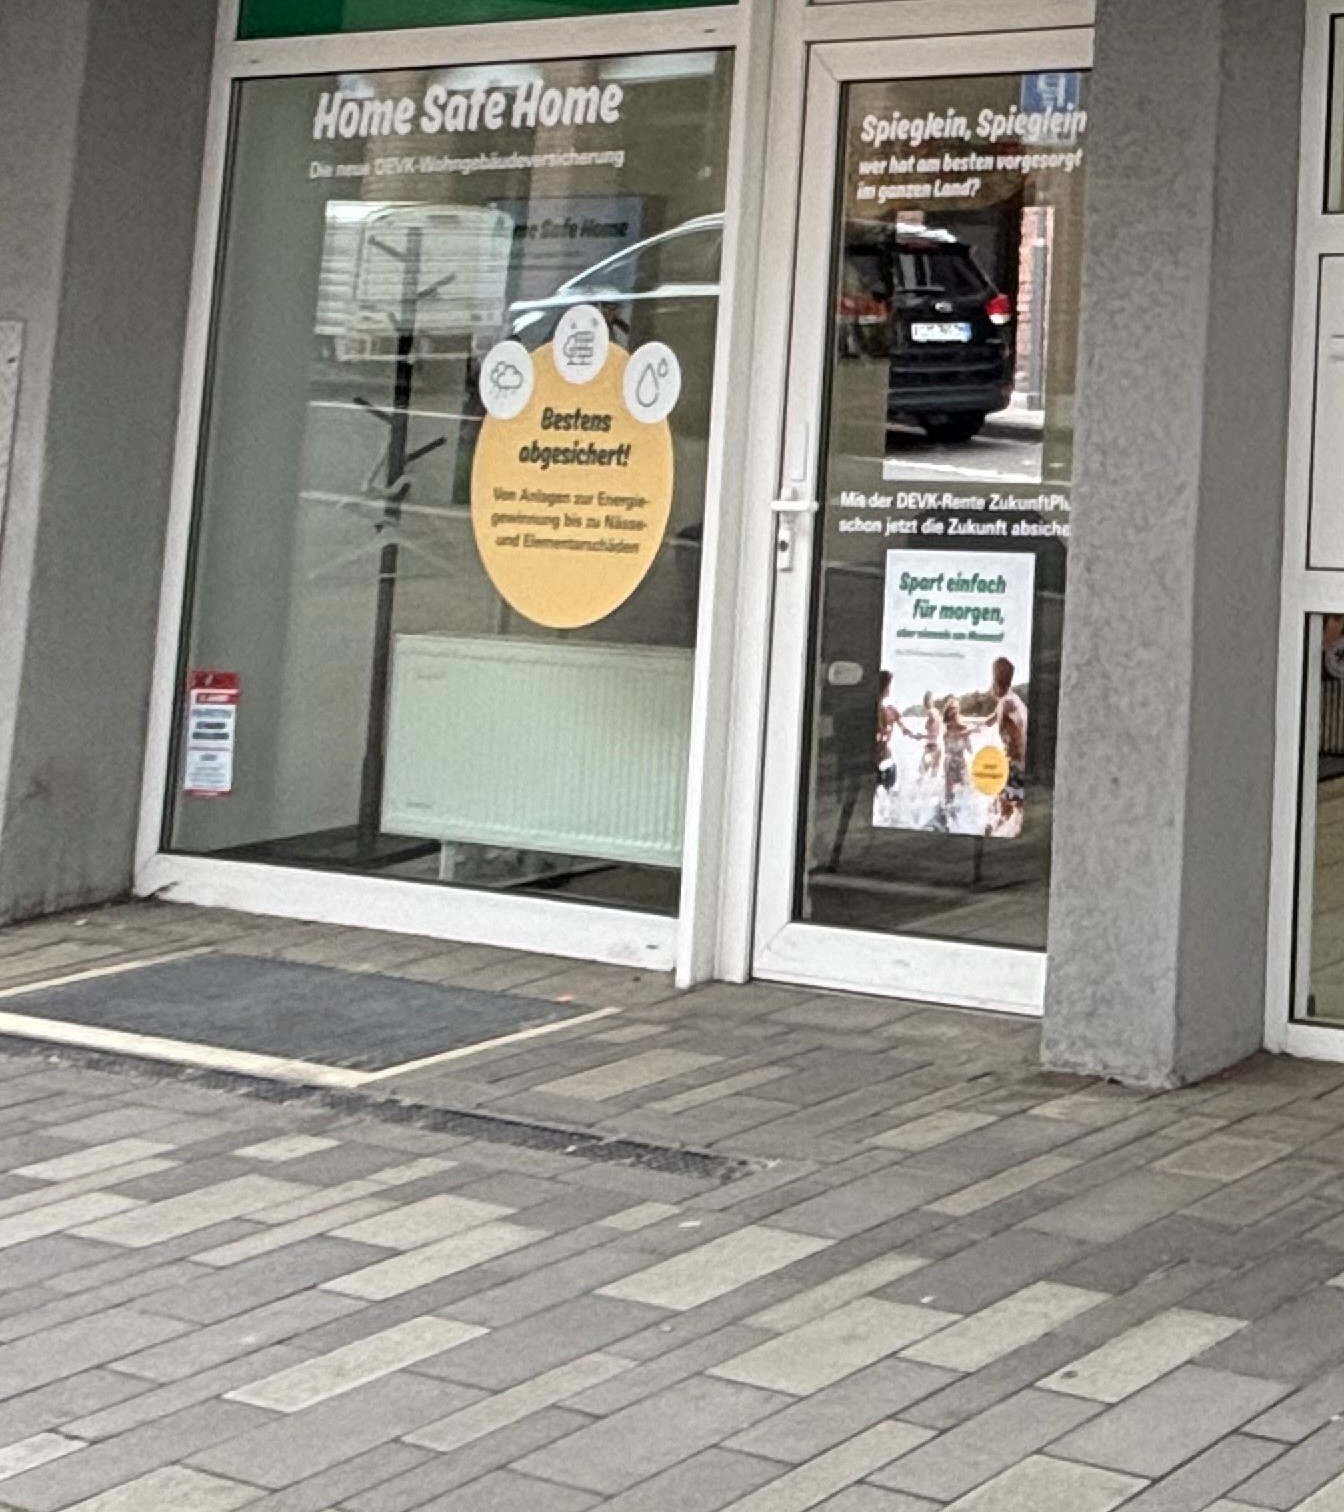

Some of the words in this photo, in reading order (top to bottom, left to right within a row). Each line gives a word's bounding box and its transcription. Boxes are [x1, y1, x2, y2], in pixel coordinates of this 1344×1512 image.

[312, 92, 416, 139] Home
[420, 84, 506, 133] Safe
[511, 79, 624, 128] Home
[861, 108, 972, 147] Spieglein,
[942, 152, 994, 172] besten
[541, 406, 613, 433] Bestens
[519, 439, 632, 472] abgesichert!
[868, 492, 893, 509] der
[884, 516, 918, 537] jetzt
[948, 518, 1008, 536] Zukunft
[1010, 519, 1071, 537] absiche
[946, 571, 1007, 594] einfach
